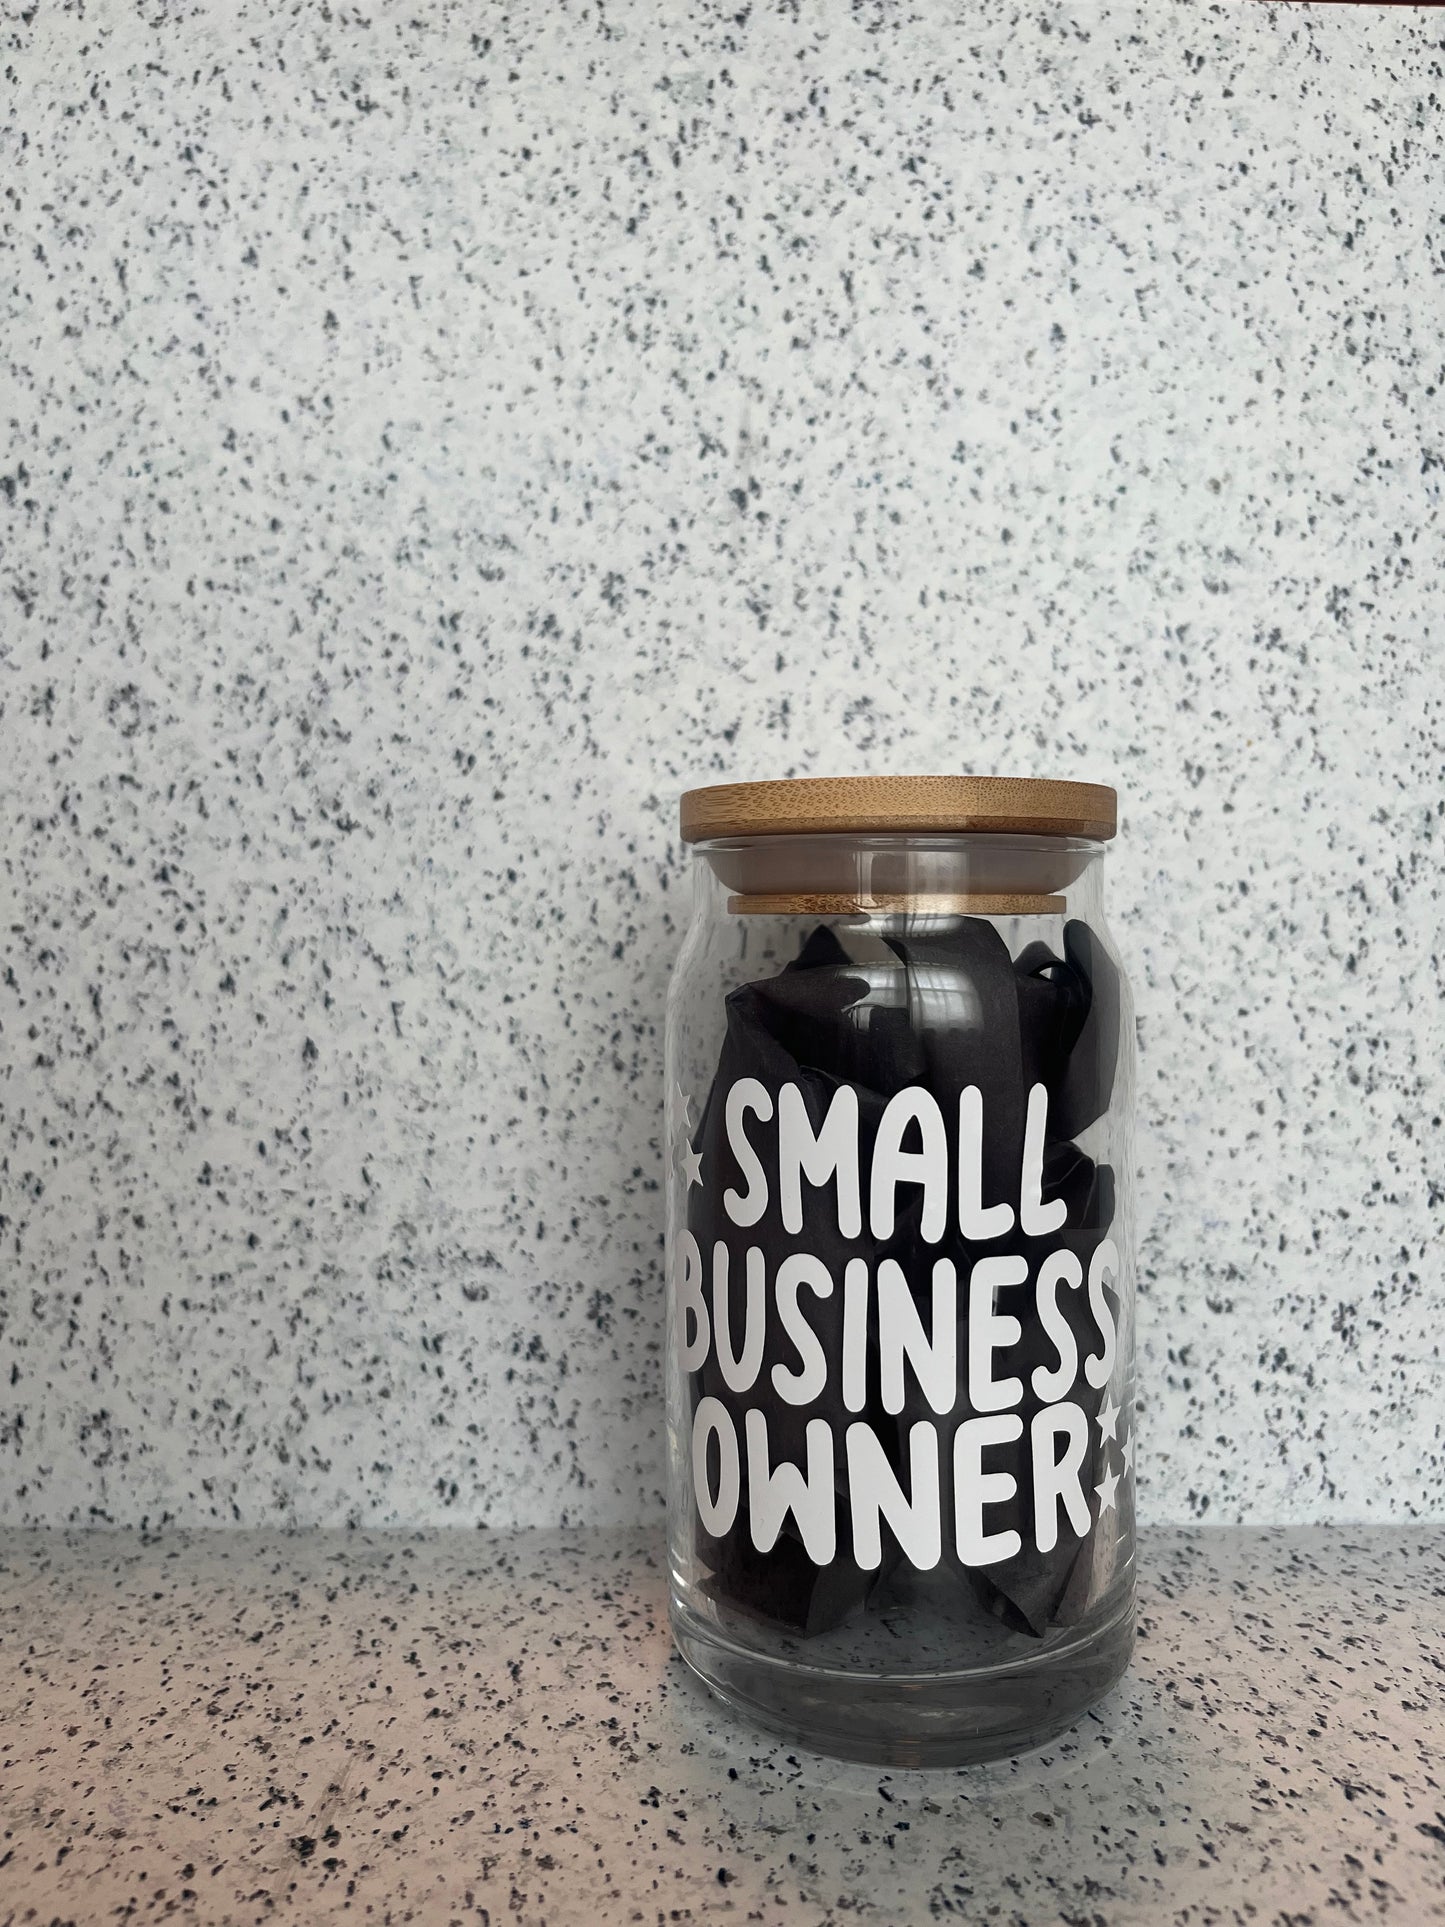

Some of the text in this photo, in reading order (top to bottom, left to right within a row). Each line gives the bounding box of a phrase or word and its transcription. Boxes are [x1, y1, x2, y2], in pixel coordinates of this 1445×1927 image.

[723, 1077, 1067, 1243] SMALL
[678, 1229, 1119, 1415] BUSINESS
[692, 1396, 1091, 1570] OWNER
